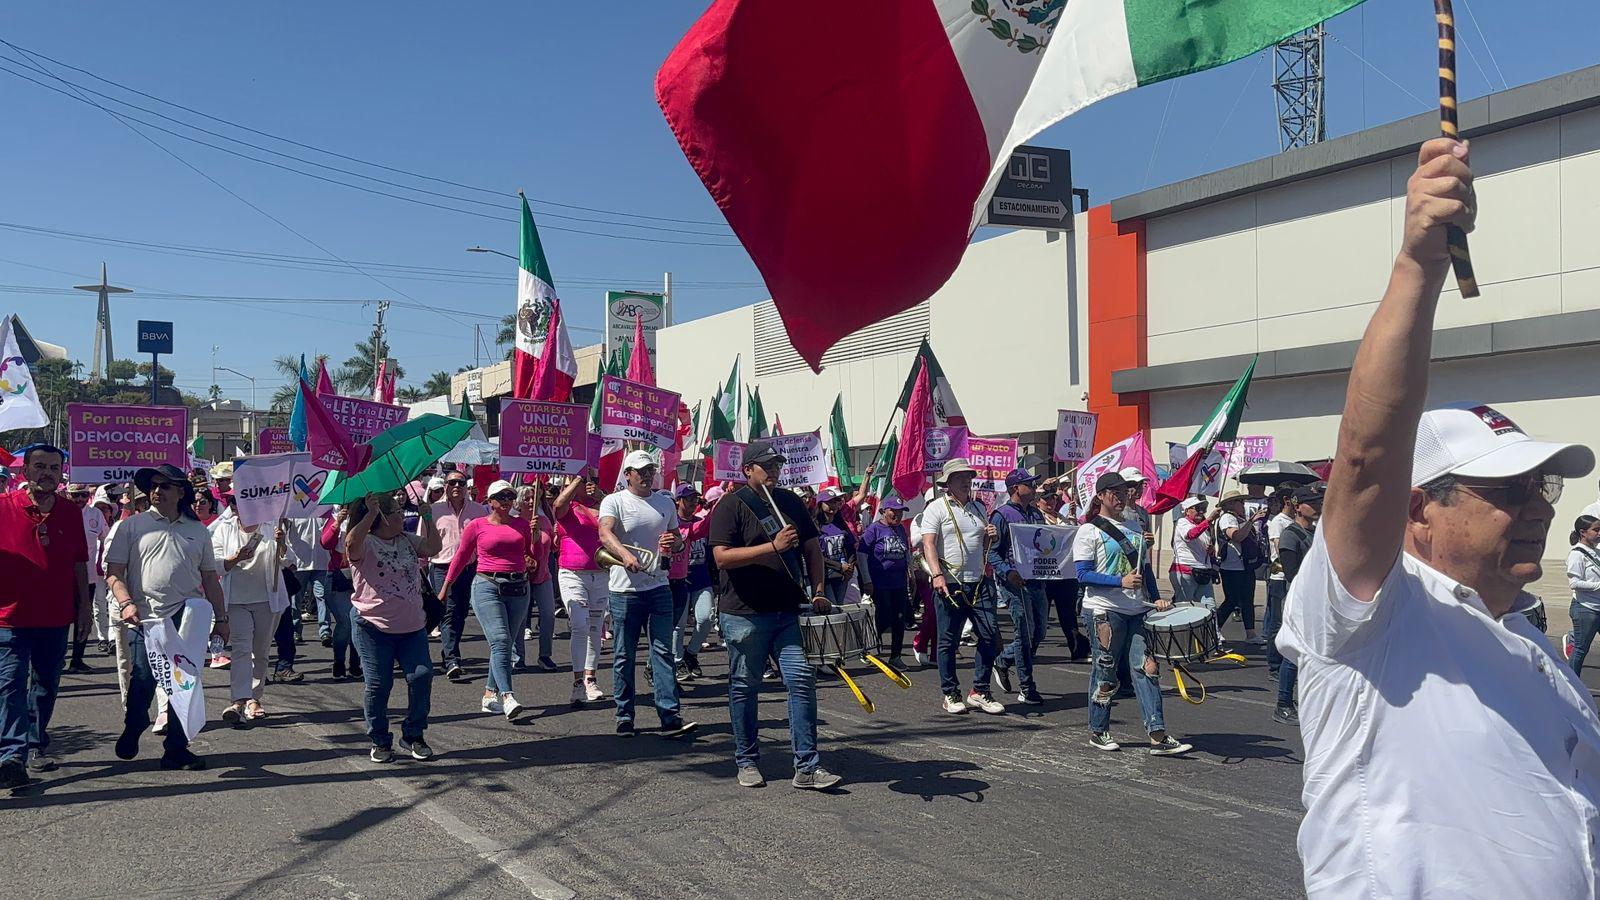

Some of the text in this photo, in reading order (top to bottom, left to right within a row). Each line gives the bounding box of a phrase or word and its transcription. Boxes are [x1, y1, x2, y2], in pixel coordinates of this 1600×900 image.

[999, 201, 1060, 214] ESTACIONAMIENTO
[141, 332, 170, 341] BBVA
[626, 385, 659, 403] Por Tu
[332, 399, 360, 415] LEY
[377, 406, 403, 422] LEY
[518, 403, 574, 415] VOTAR ES LA
[607, 393, 652, 413] Derecho
[654, 408, 660, 416] a
[82, 411, 174, 427] Por nuestra
[333, 413, 391, 431] RESPETO
[522, 412, 569, 428] UNICA
[74, 430, 181, 444] DEMOCRACIA
[520, 425, 573, 436] MANERA DE
[523, 435, 569, 445] HACER UN
[1253, 438, 1270, 448] LEY
[88, 446, 168, 463] Estoy aquí
[518, 443, 573, 458] CAMBIO
[780, 446, 809, 455] Nuestra
[970, 454, 1012, 467] IBRE!!
[103, 466, 135, 480] SÚM
[161, 653, 174, 696] PODER
